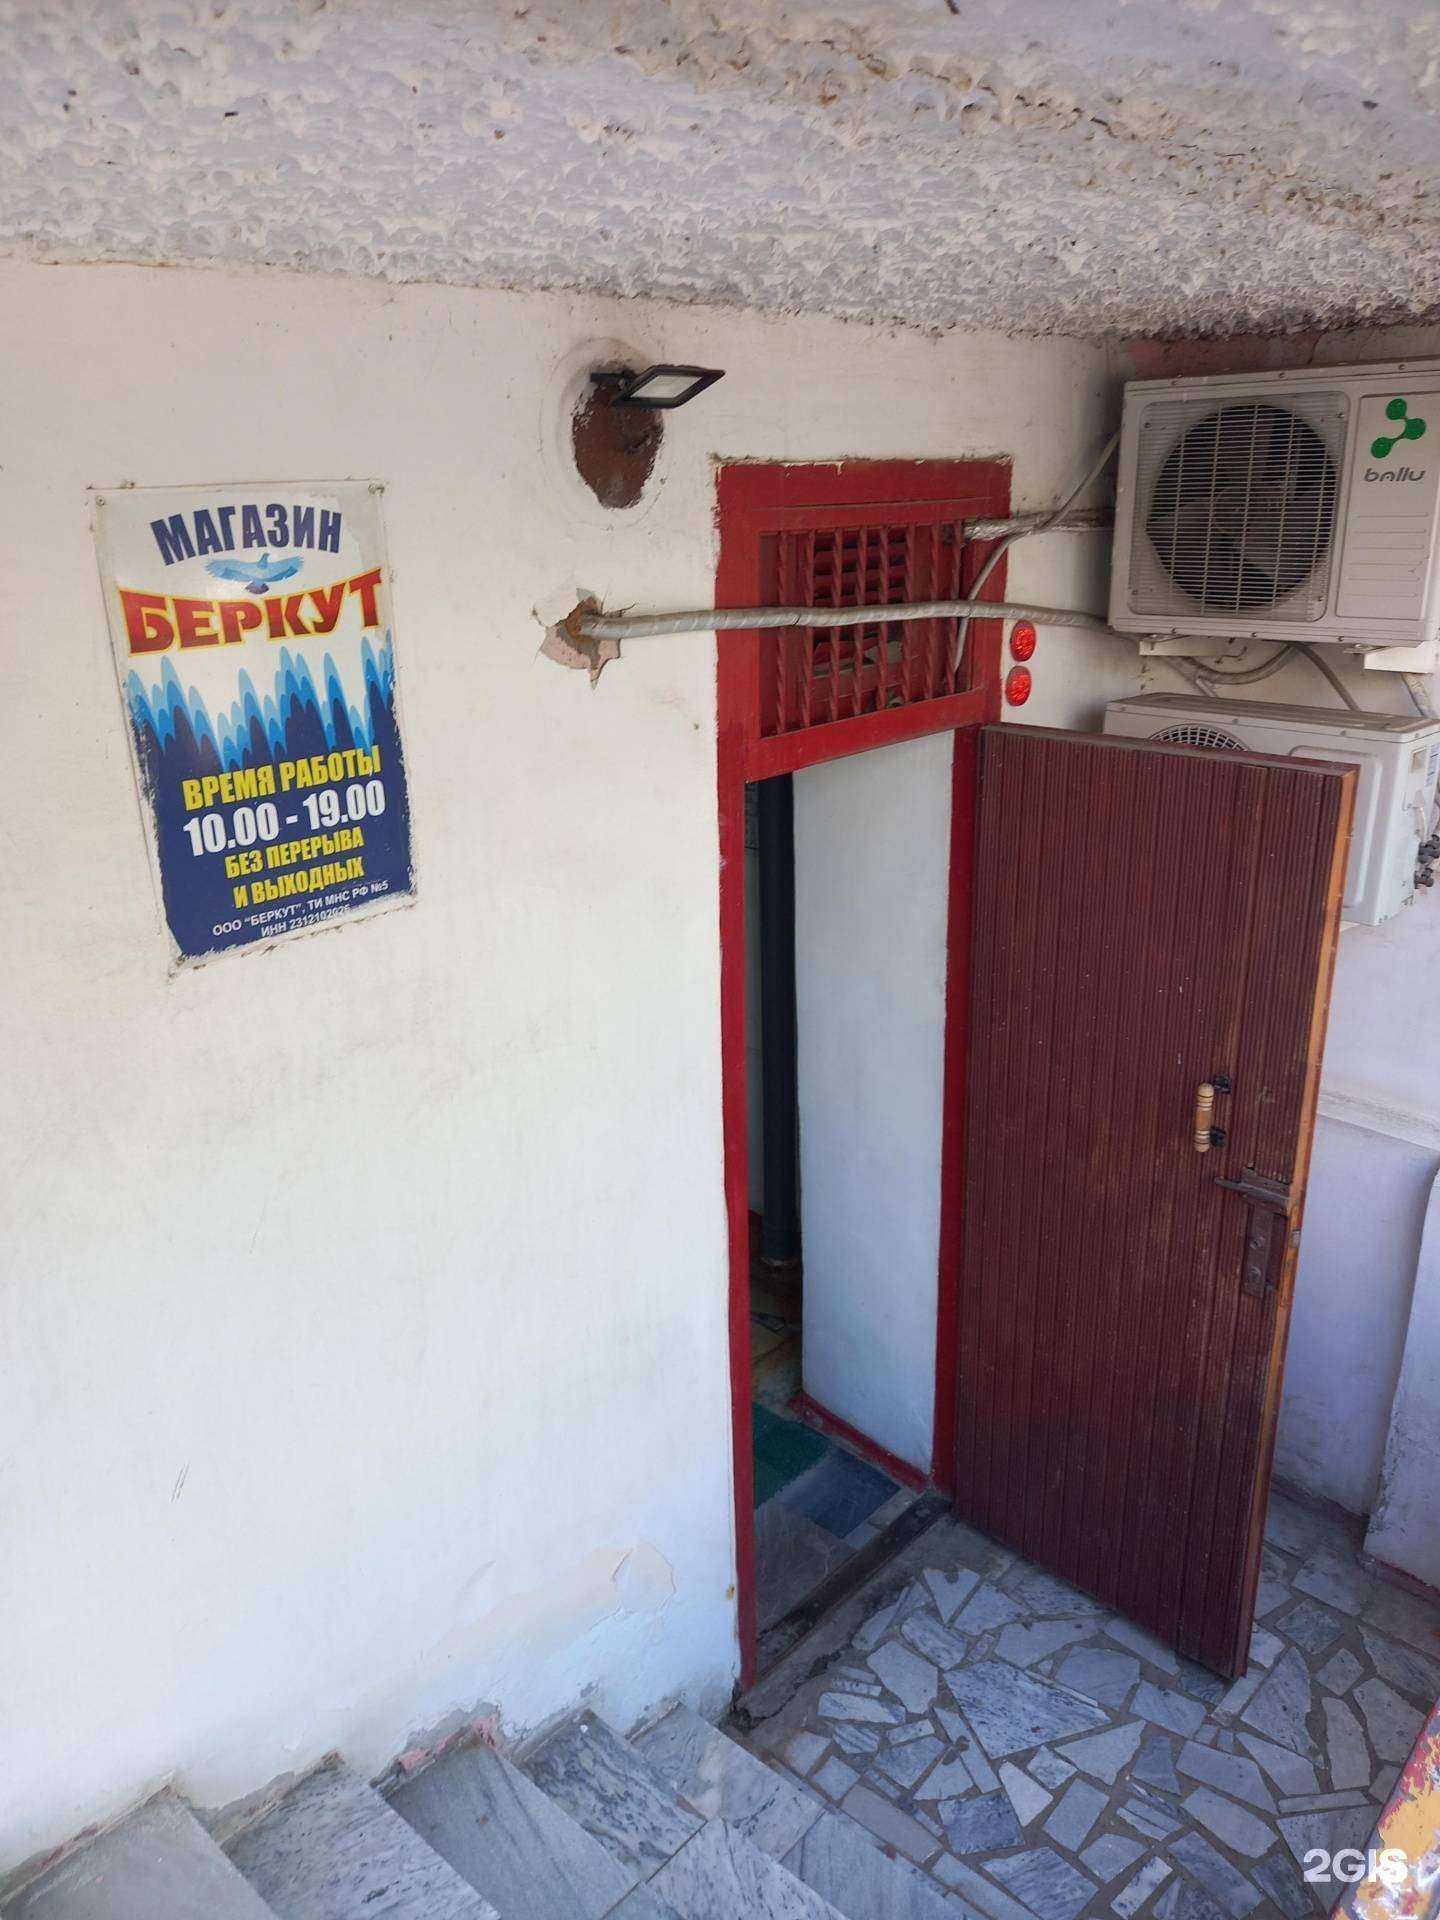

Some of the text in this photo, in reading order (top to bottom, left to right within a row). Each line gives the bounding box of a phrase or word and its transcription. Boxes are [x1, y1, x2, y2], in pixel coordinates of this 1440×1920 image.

[150, 503, 342, 566] МАГАЗИН
[118, 568, 382, 657] БЕРКУТ
[182, 745, 382, 811] ВРЕМЯ РАБОТЫ
[183, 802, 279, 856] 10.00
[303, 779, 386, 830] 19.00
[225, 826, 365, 879] БЕЗ ПЕРЕРЫВА
[212, 919, 242, 936] ООО
[307, 896, 323, 910] ТИ
[325, 889, 350, 906] МНС
[352, 887, 369, 899] РФ
[233, 856, 365, 909] И ВЫХОДНЫХ
[261, 922, 287, 937] ИНН
